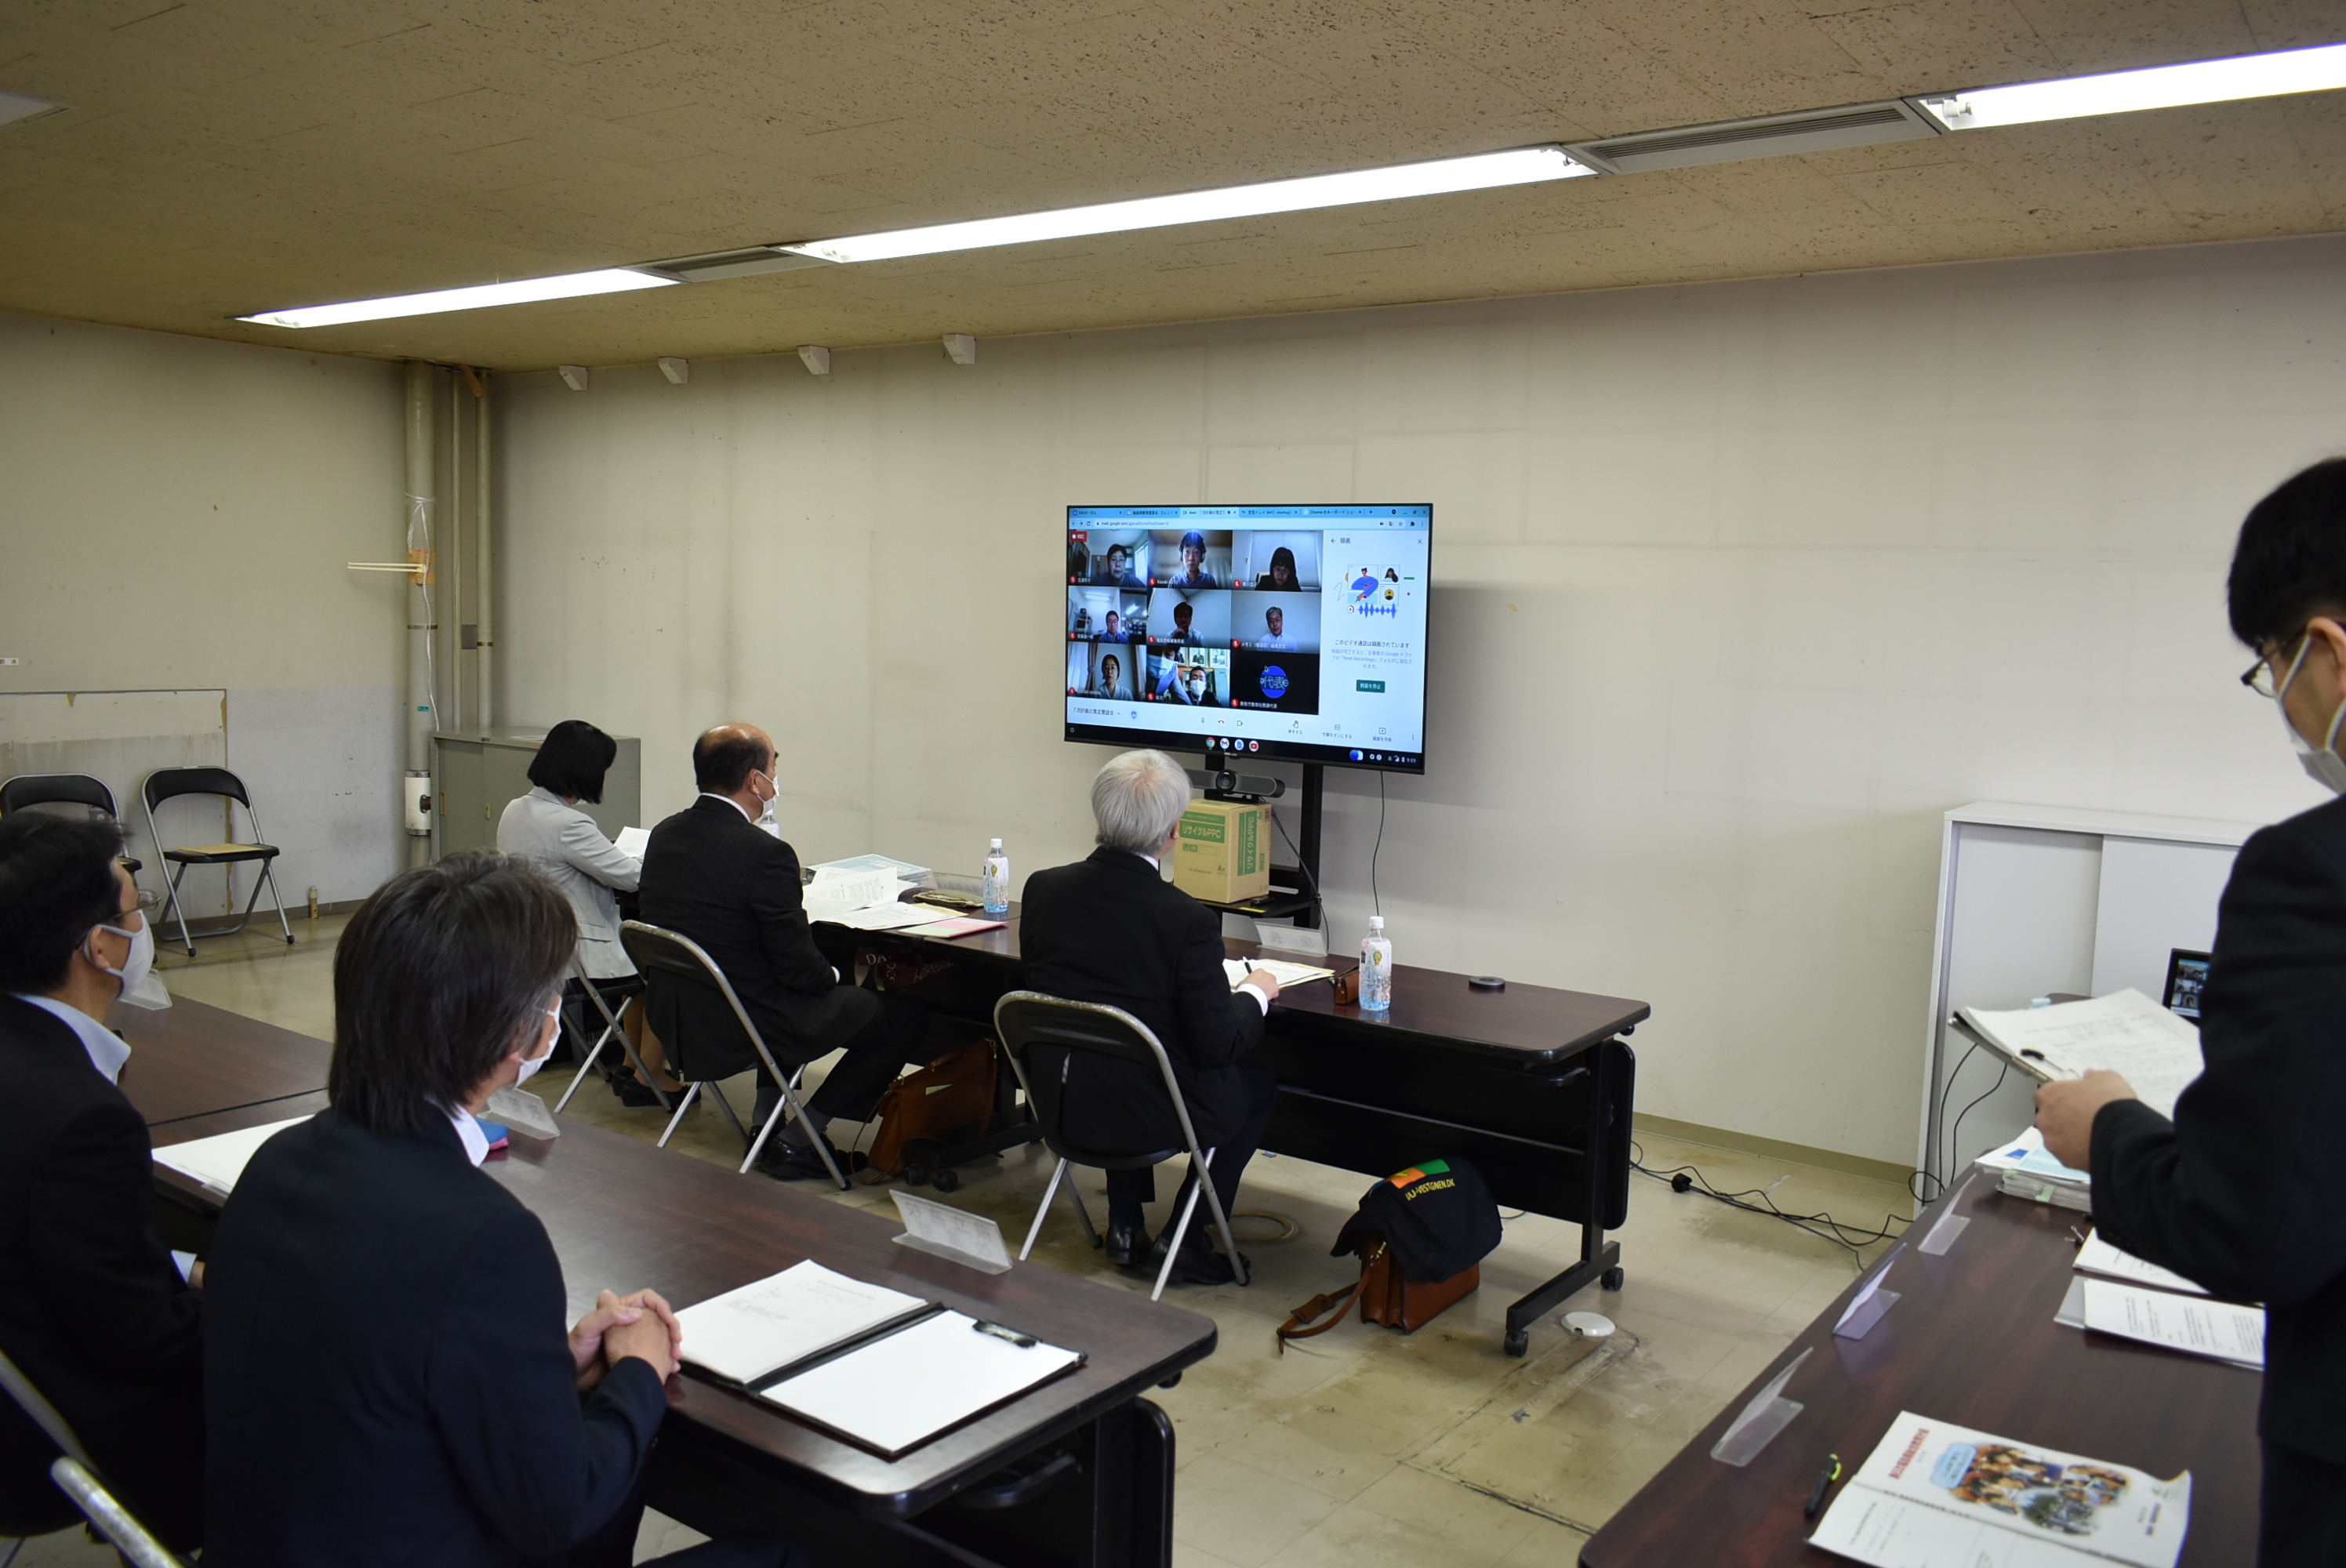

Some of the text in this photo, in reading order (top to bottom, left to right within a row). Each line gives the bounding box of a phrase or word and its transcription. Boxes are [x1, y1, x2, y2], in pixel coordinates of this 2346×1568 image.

[1335, 639, 1410, 648] このビデオ通話は録画されています
[1182, 824, 1221, 838] リサイクルPPC
